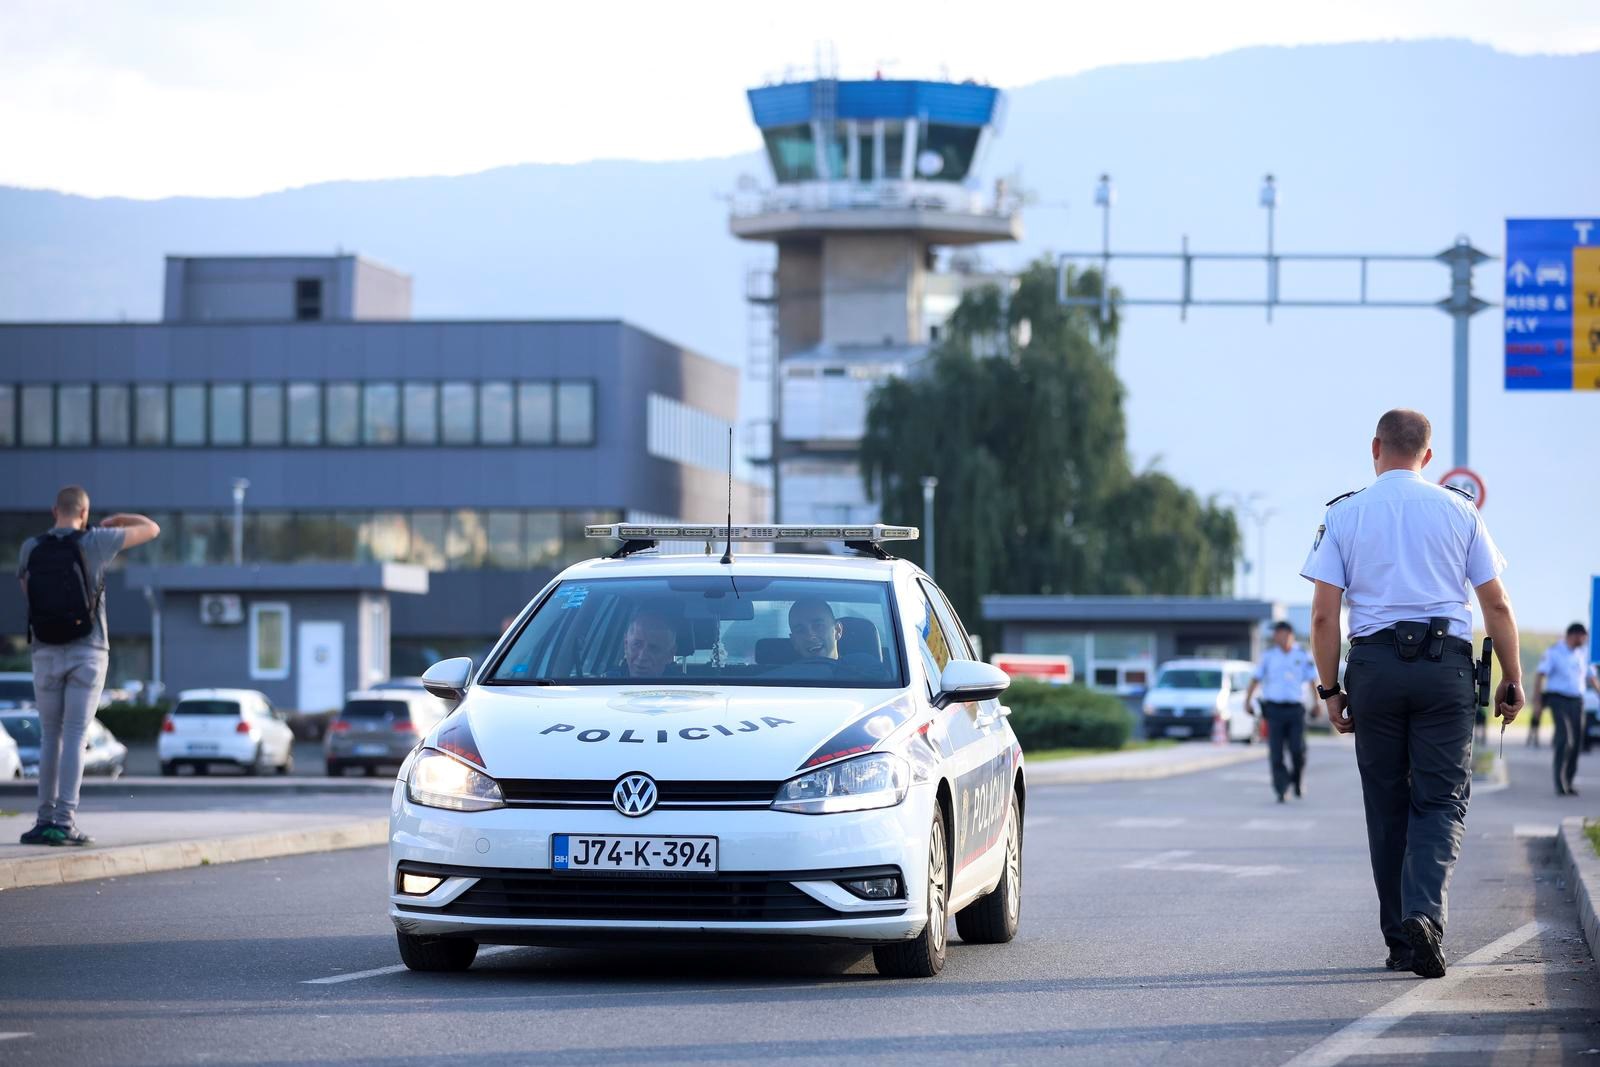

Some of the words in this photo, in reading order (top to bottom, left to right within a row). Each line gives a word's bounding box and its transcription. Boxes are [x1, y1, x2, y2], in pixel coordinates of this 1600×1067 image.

[1504, 315, 1538, 333] FLY
[539, 716, 795, 744] POLICIJA
[554, 855, 568, 863] BIH
[573, 839, 712, 868] J74-K-394
